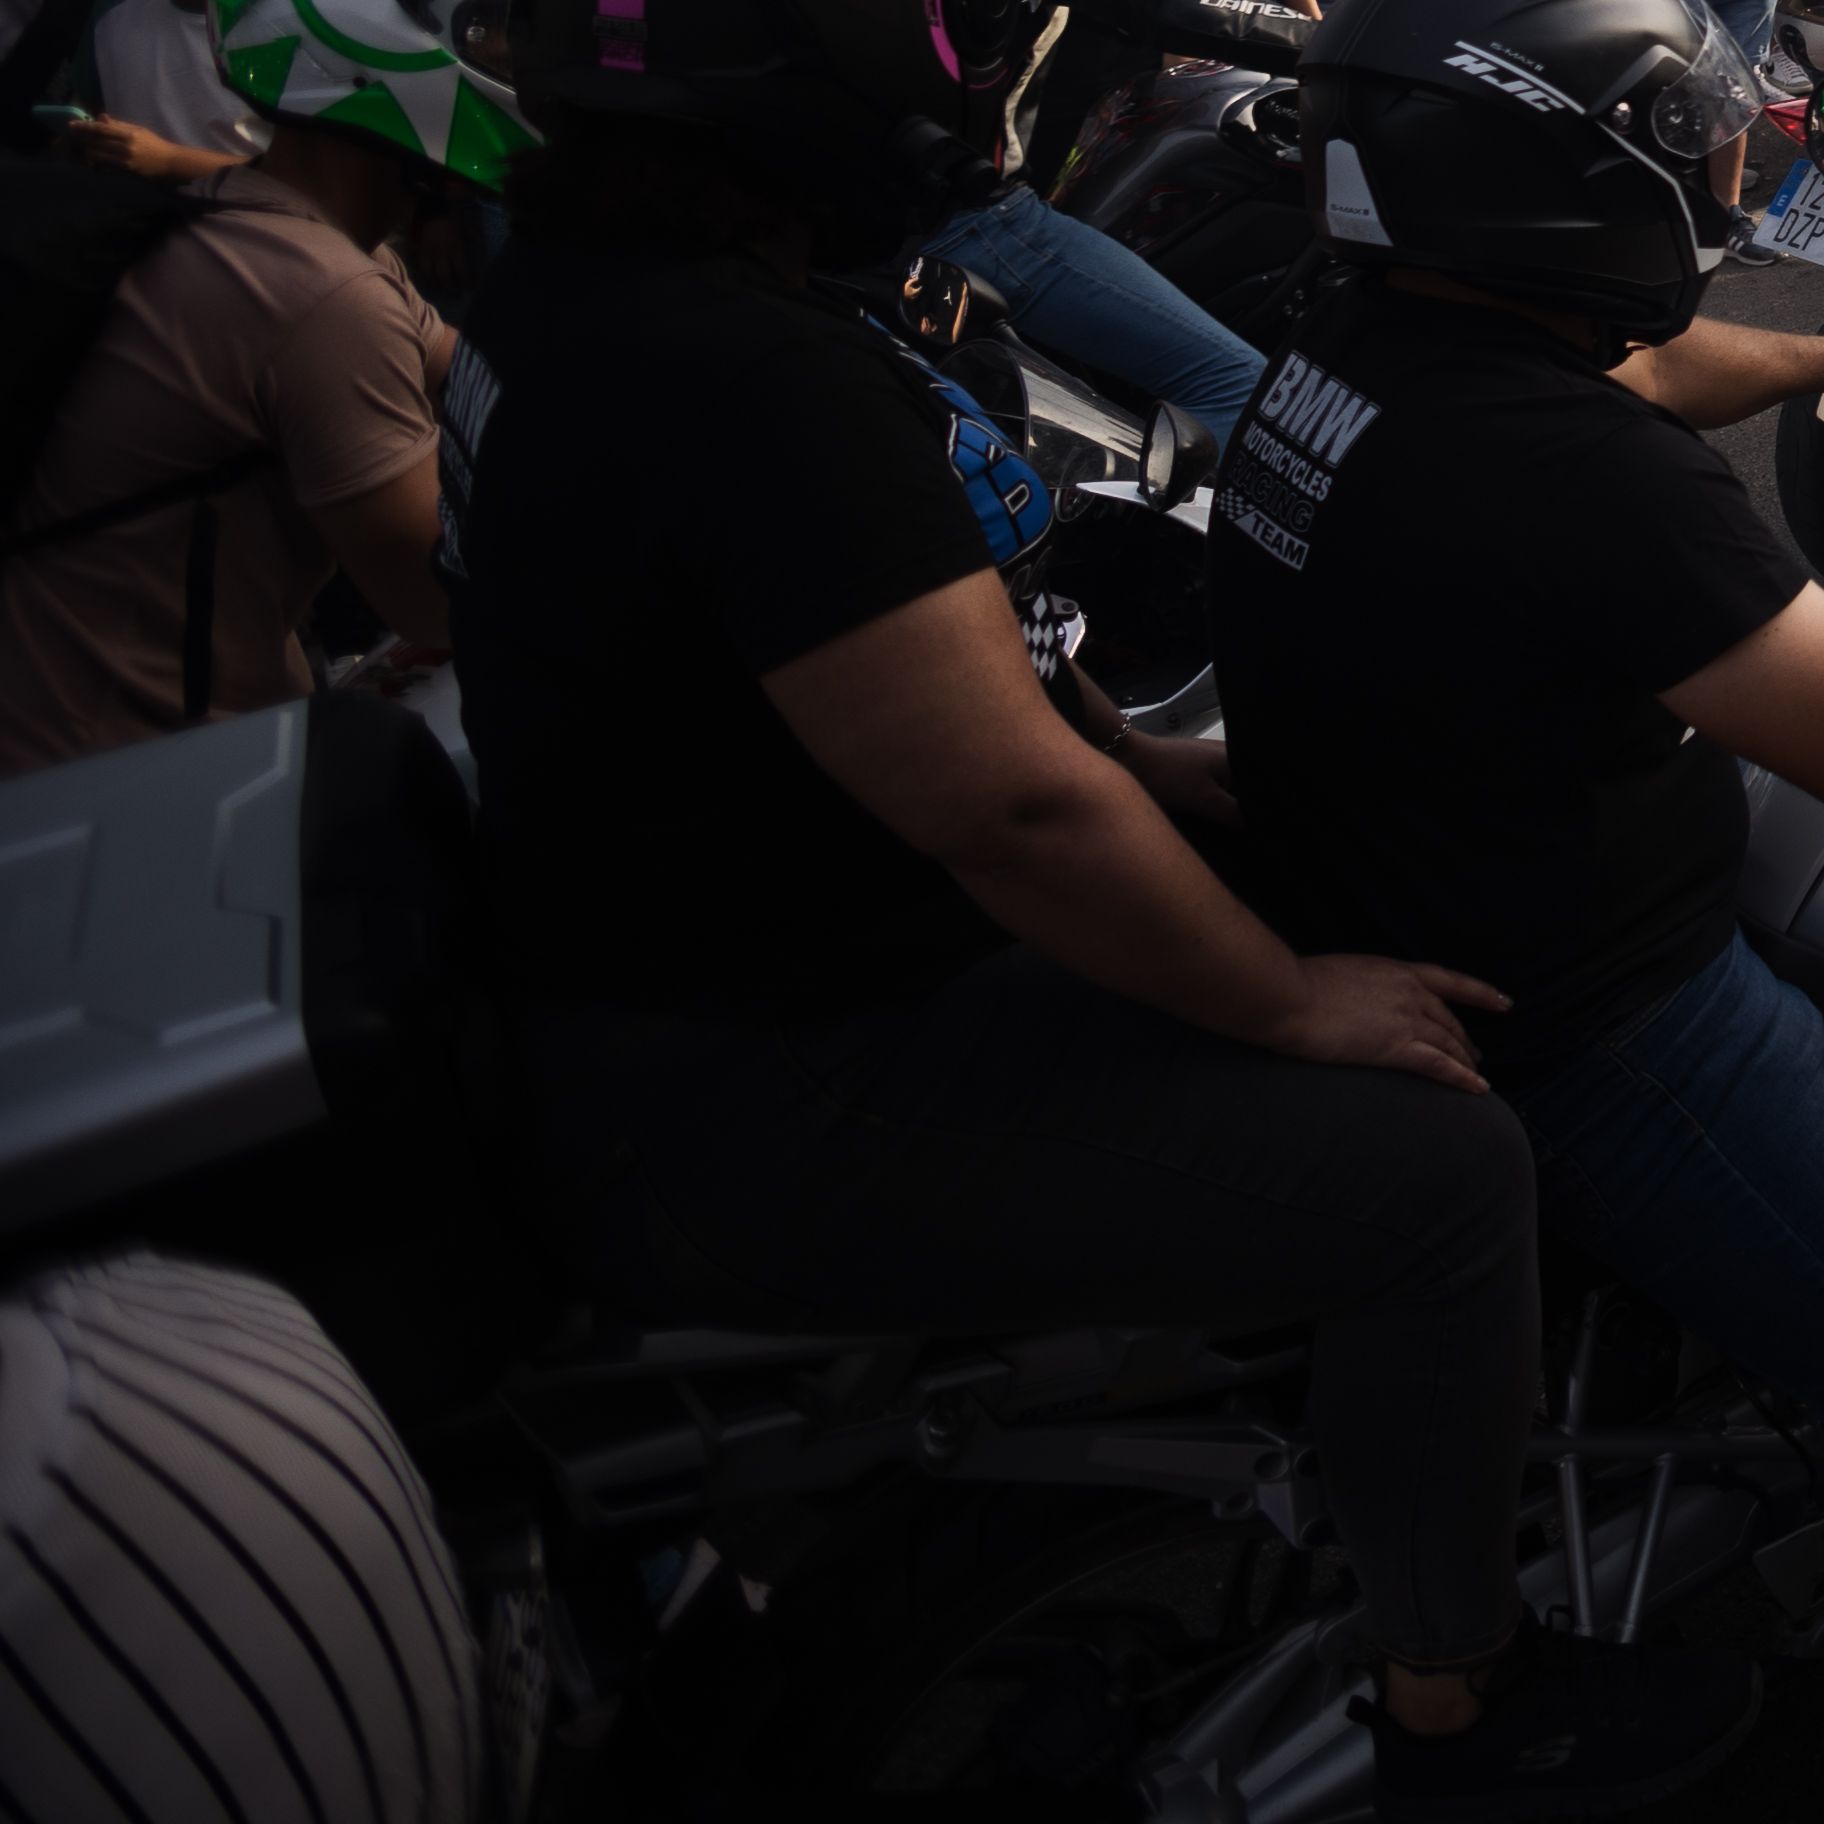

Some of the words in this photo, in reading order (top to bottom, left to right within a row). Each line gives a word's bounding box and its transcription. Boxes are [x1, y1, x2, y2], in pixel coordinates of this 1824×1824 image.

[1443, 53, 1567, 112] HJC
[1776, 194, 1789, 209] E
[1258, 350, 1383, 471] BMW
[1230, 455, 1317, 537] RACING
[1241, 420, 1335, 506] MOTORCYCLES
[1250, 517, 1307, 564] TEAM
